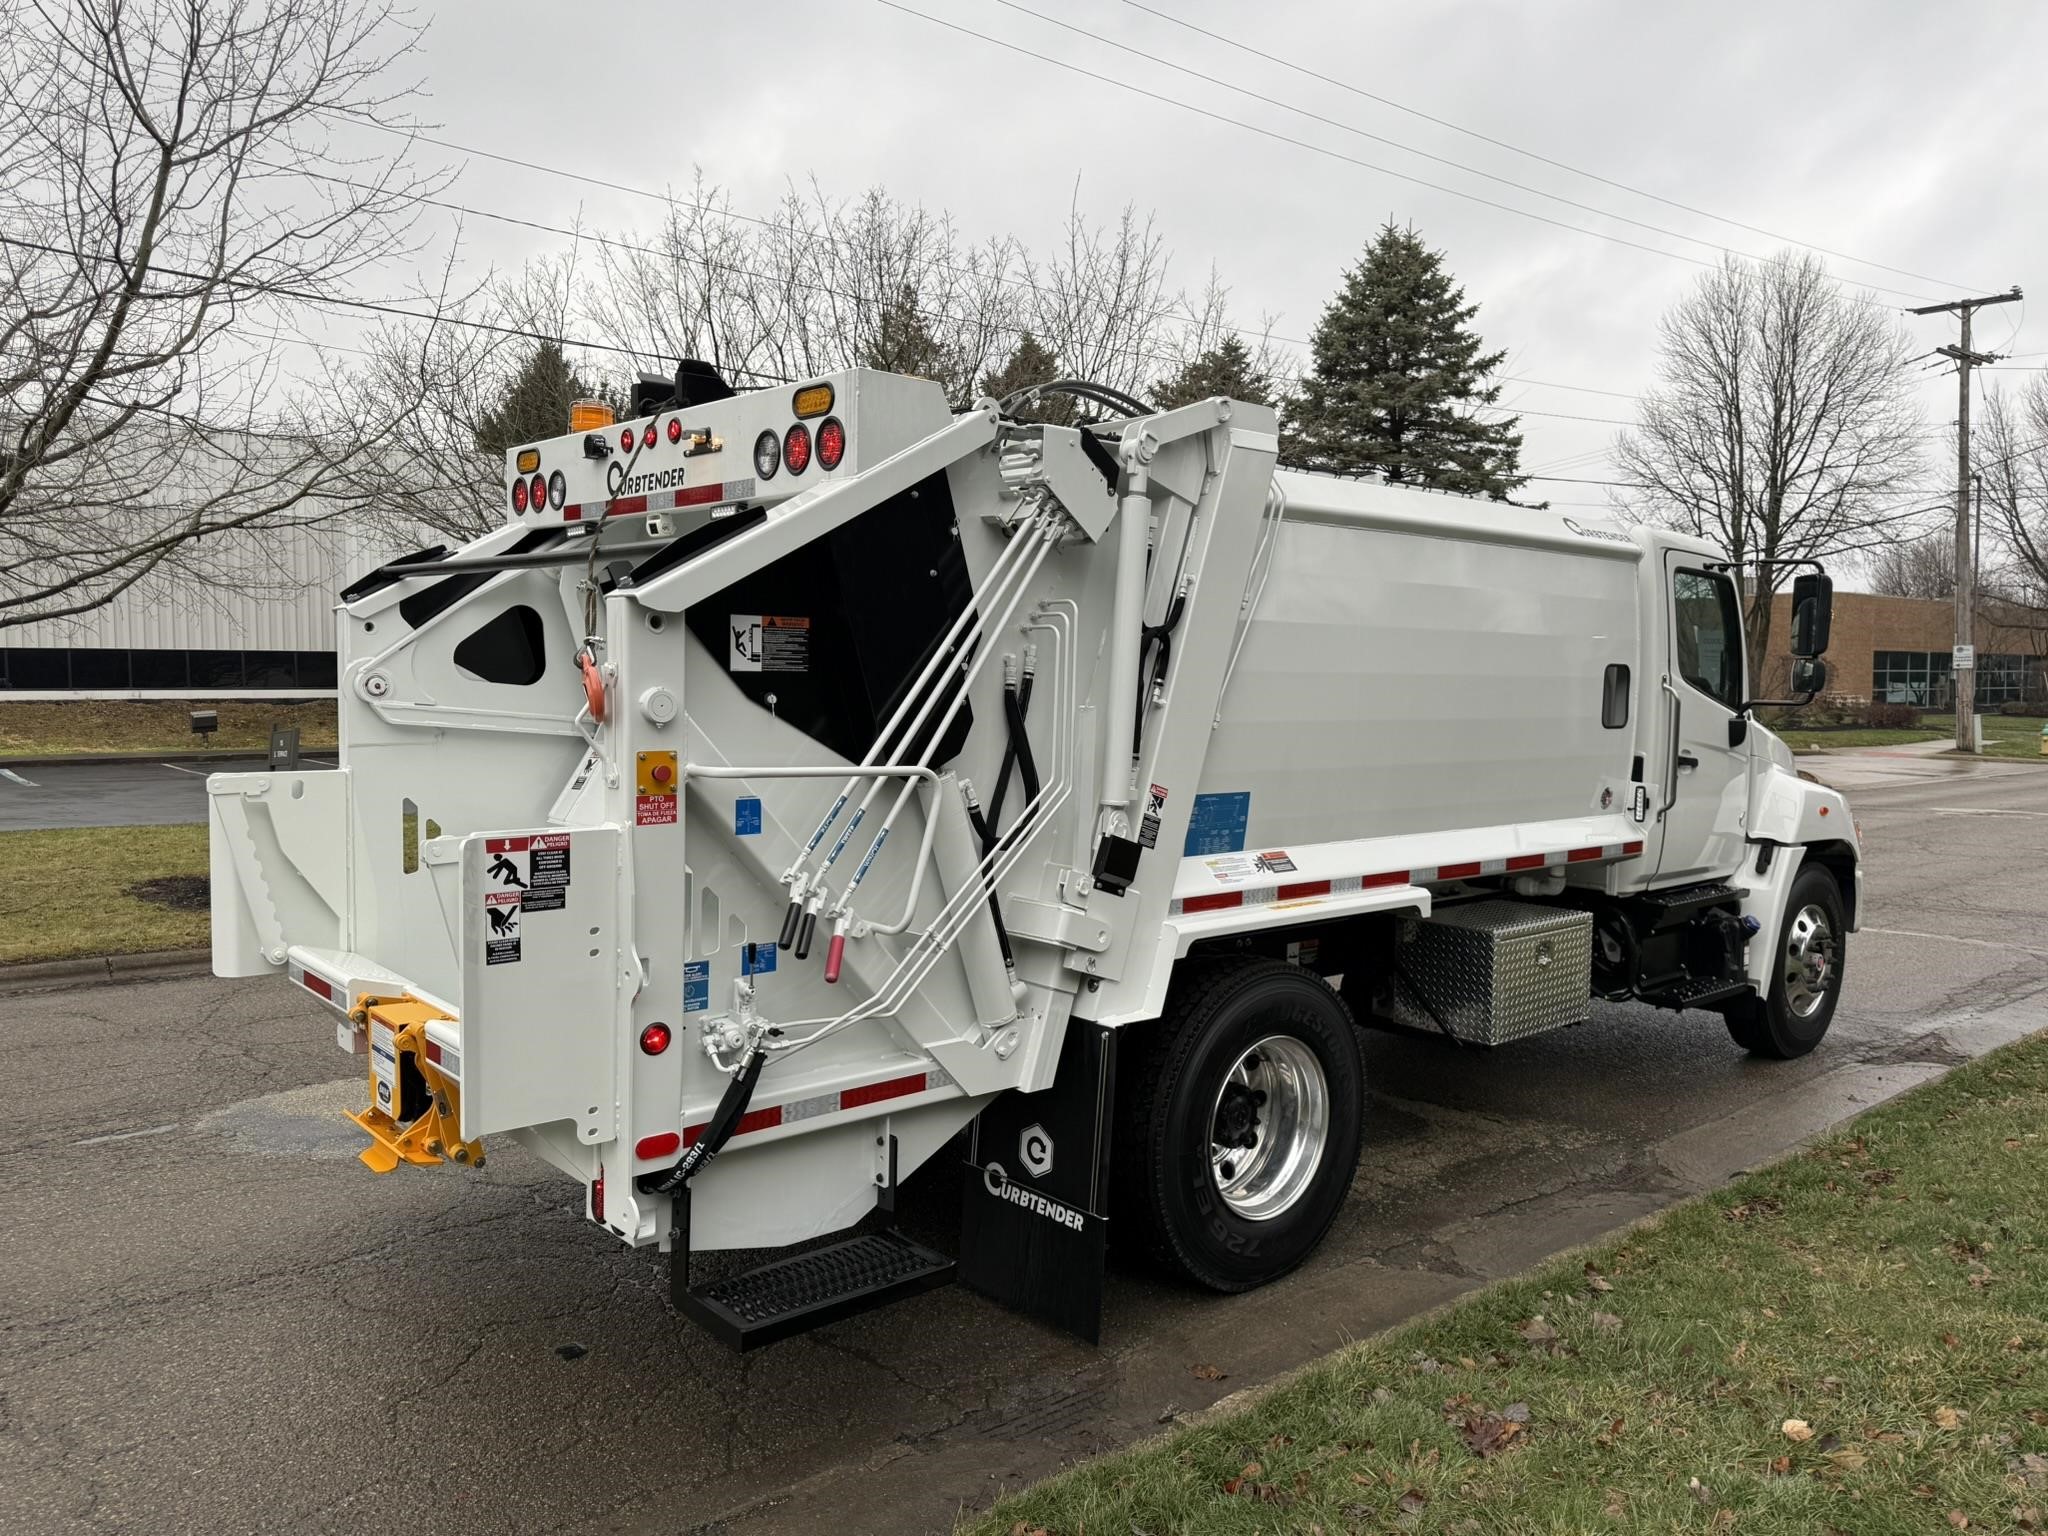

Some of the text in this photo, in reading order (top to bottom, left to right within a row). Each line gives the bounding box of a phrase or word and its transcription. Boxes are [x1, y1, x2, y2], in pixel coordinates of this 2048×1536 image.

[607, 461, 684, 497] CURBTENDER
[650, 795, 664, 803] PTO
[640, 801, 675, 811] SHUT OFF
[642, 815, 672, 824] APAGAR
[544, 834, 570, 843] DANGER
[497, 891, 519, 899] DANGER
[984, 1162, 1084, 1232] CURBTENDER
